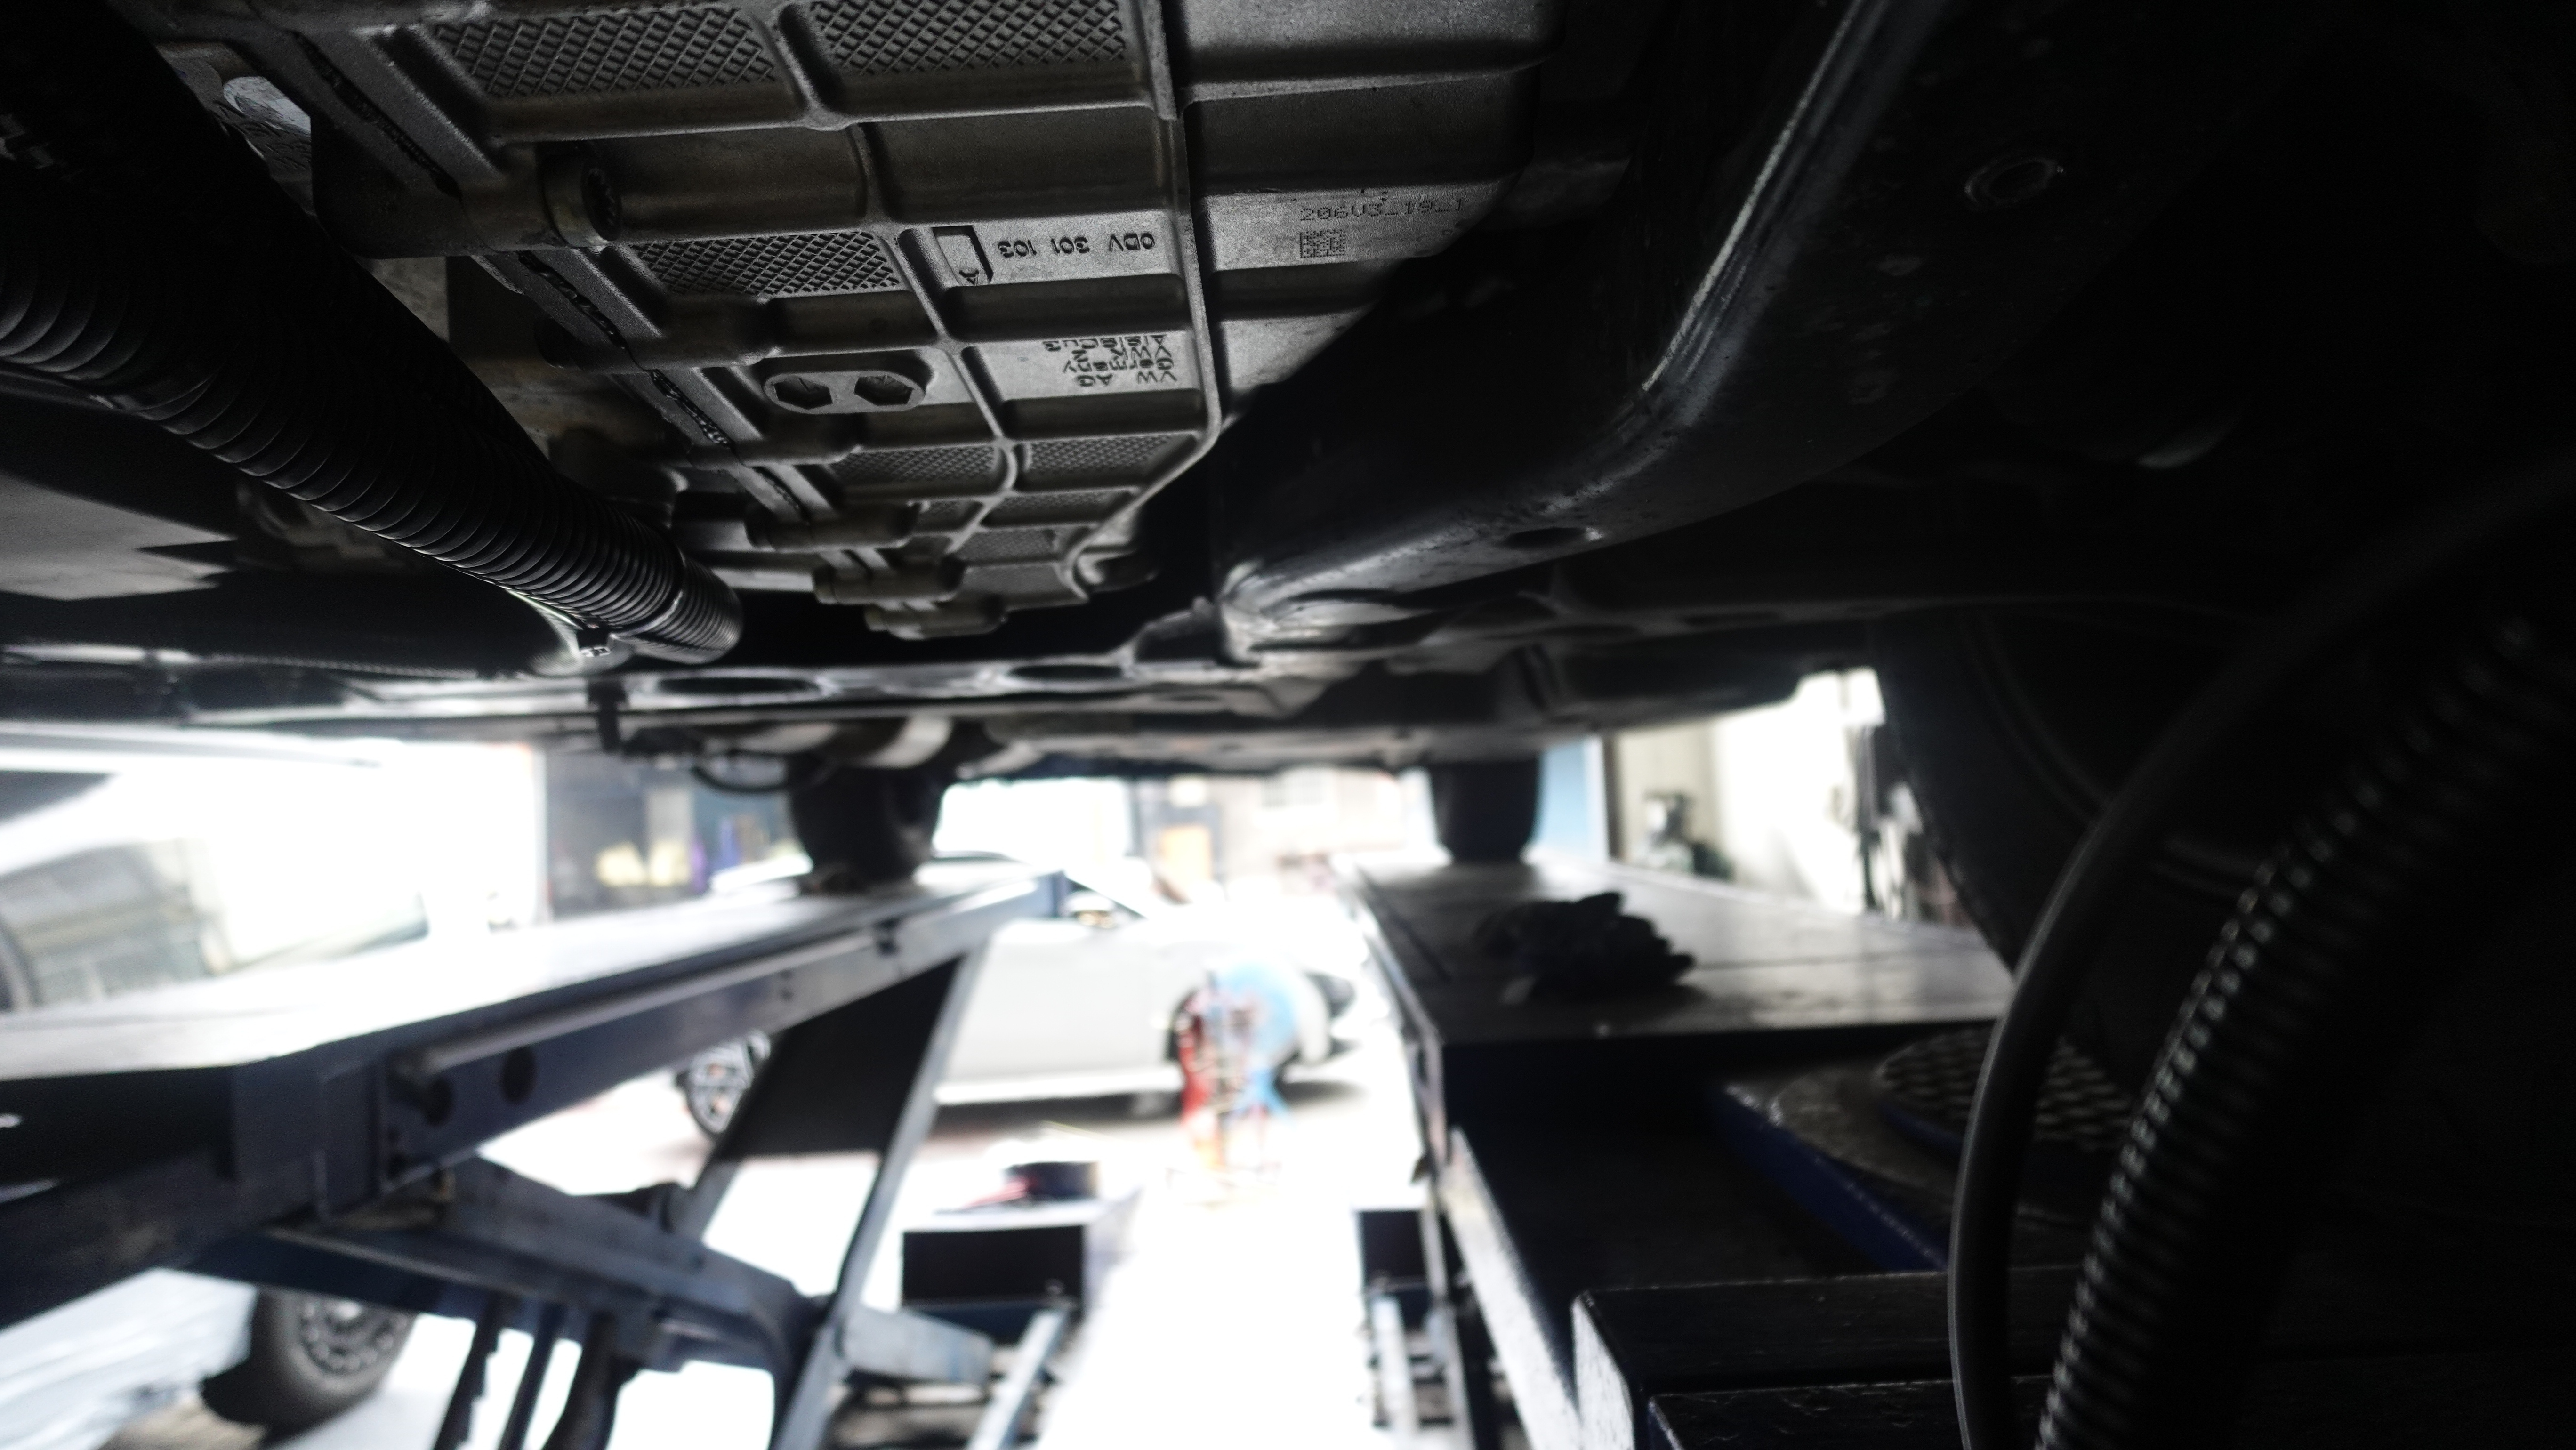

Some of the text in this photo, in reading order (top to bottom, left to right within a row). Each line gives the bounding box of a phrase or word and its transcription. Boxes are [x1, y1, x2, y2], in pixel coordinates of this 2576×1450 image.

[997, 239, 1037, 258] 103
[1051, 236, 1091, 254] 301
[1063, 357, 1175, 373] Germany
[1075, 370, 1177, 387] VW AG
